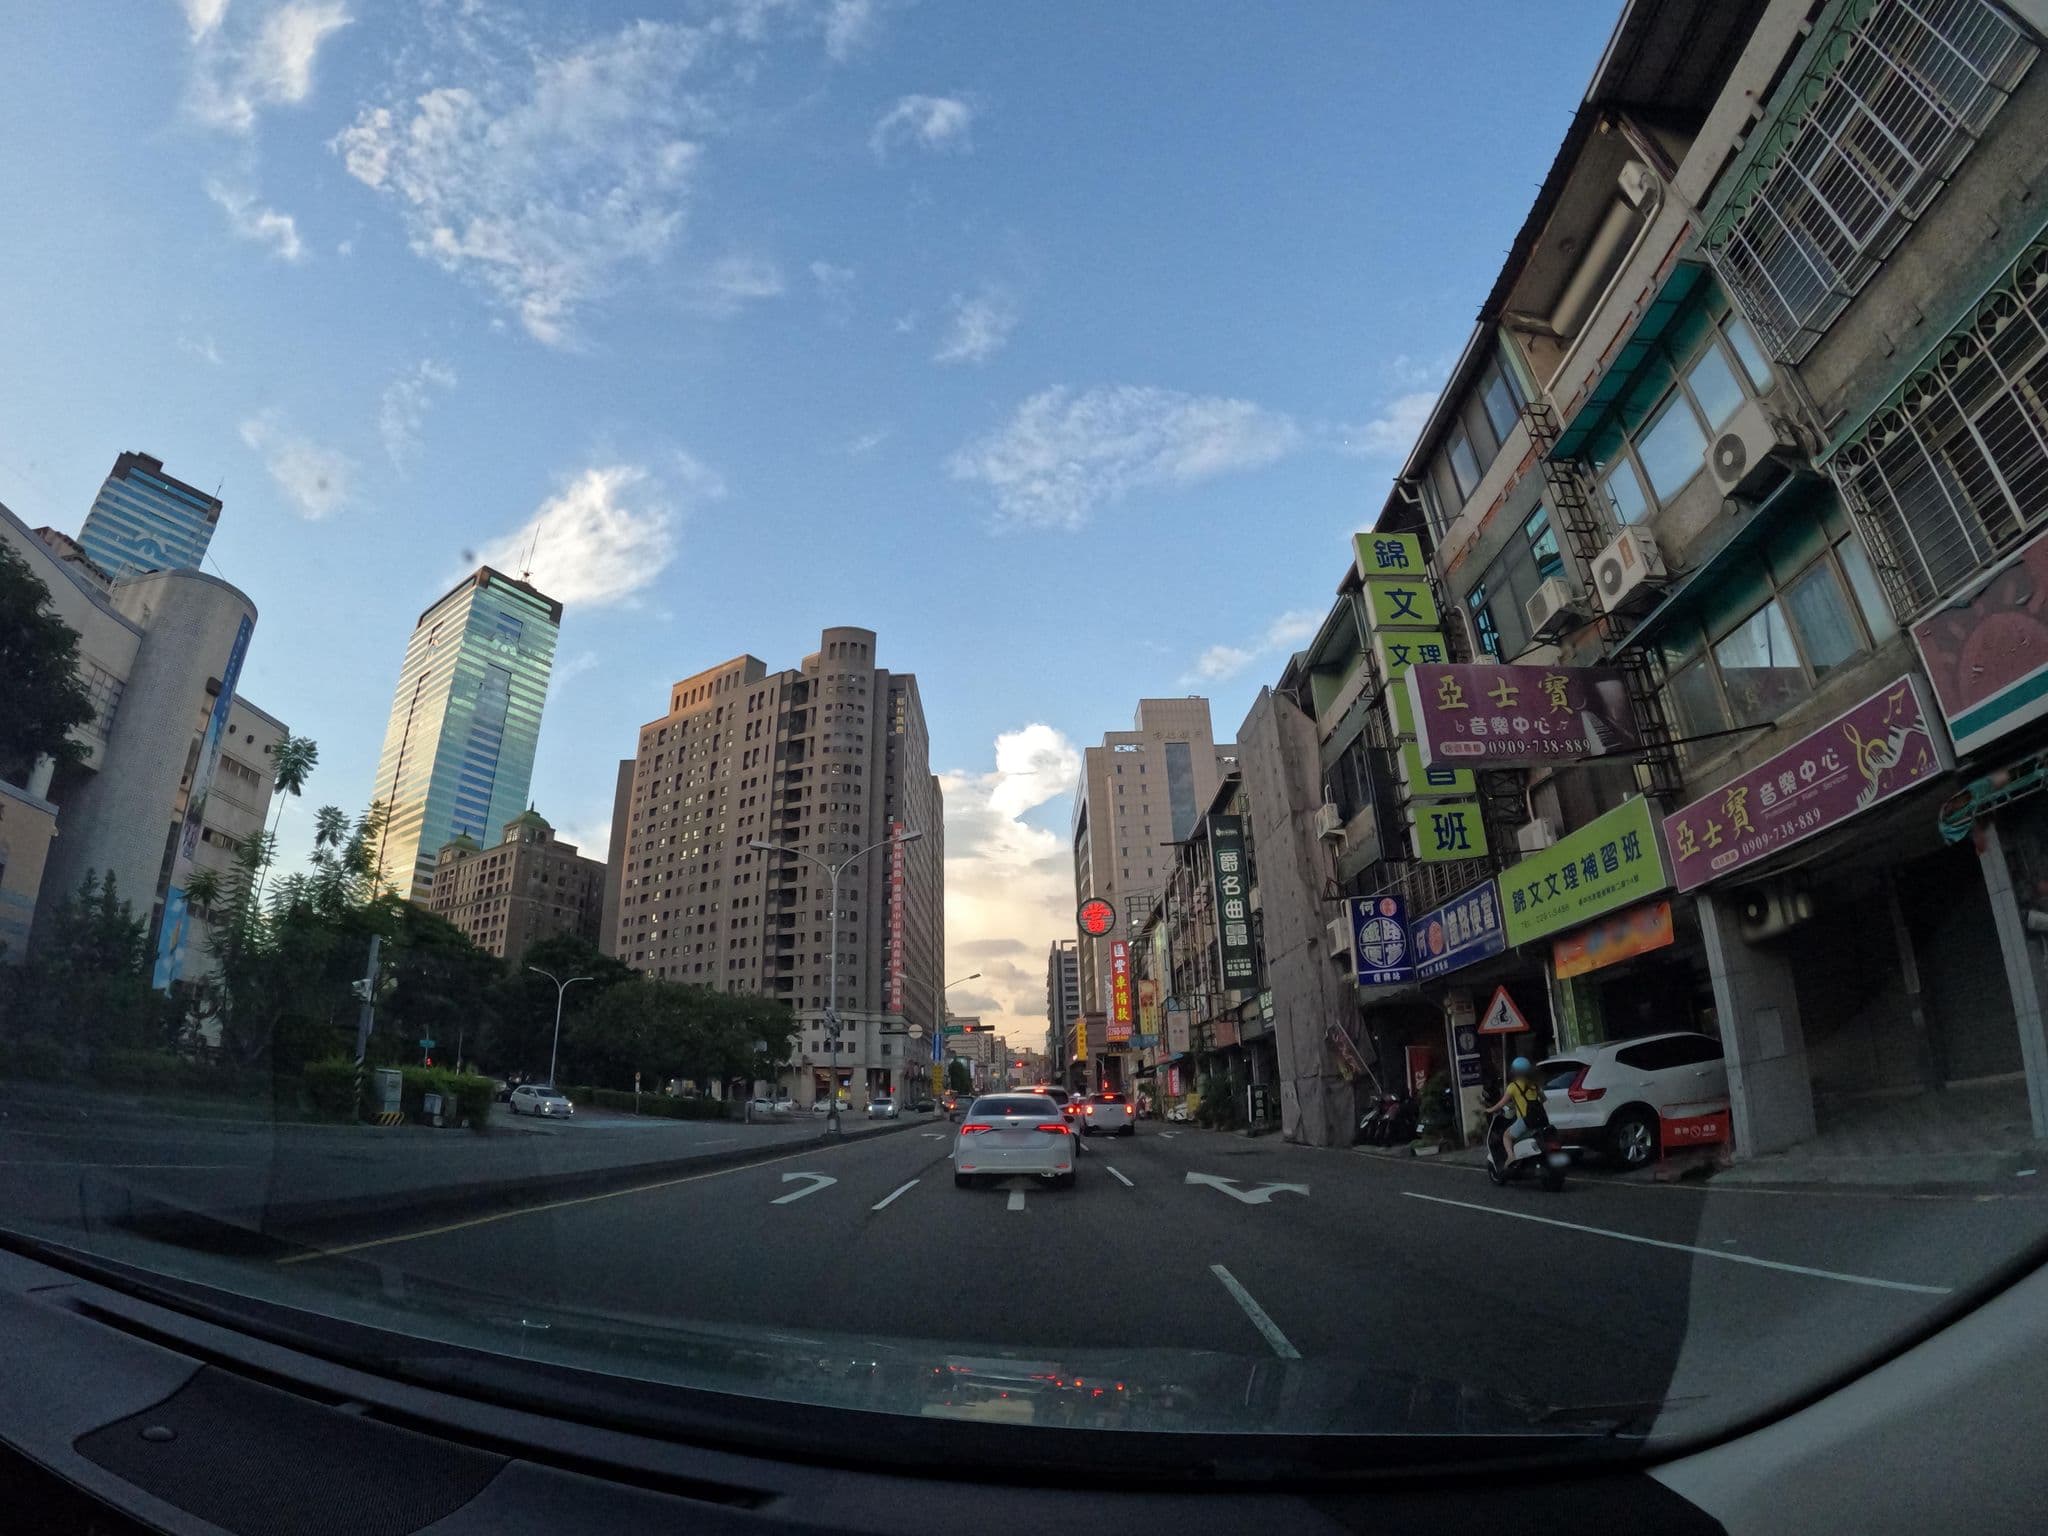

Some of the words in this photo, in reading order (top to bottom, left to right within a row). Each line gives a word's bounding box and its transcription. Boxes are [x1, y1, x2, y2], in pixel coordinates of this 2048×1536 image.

[1437, 673, 1574, 715] 亞士寶
[1469, 716, 1551, 736] 音樂中心
[1760, 748, 1840, 806] 音樂中心
[1677, 786, 1755, 861] 亞士寶
[1512, 830, 1642, 914] 錦文文理補習班
